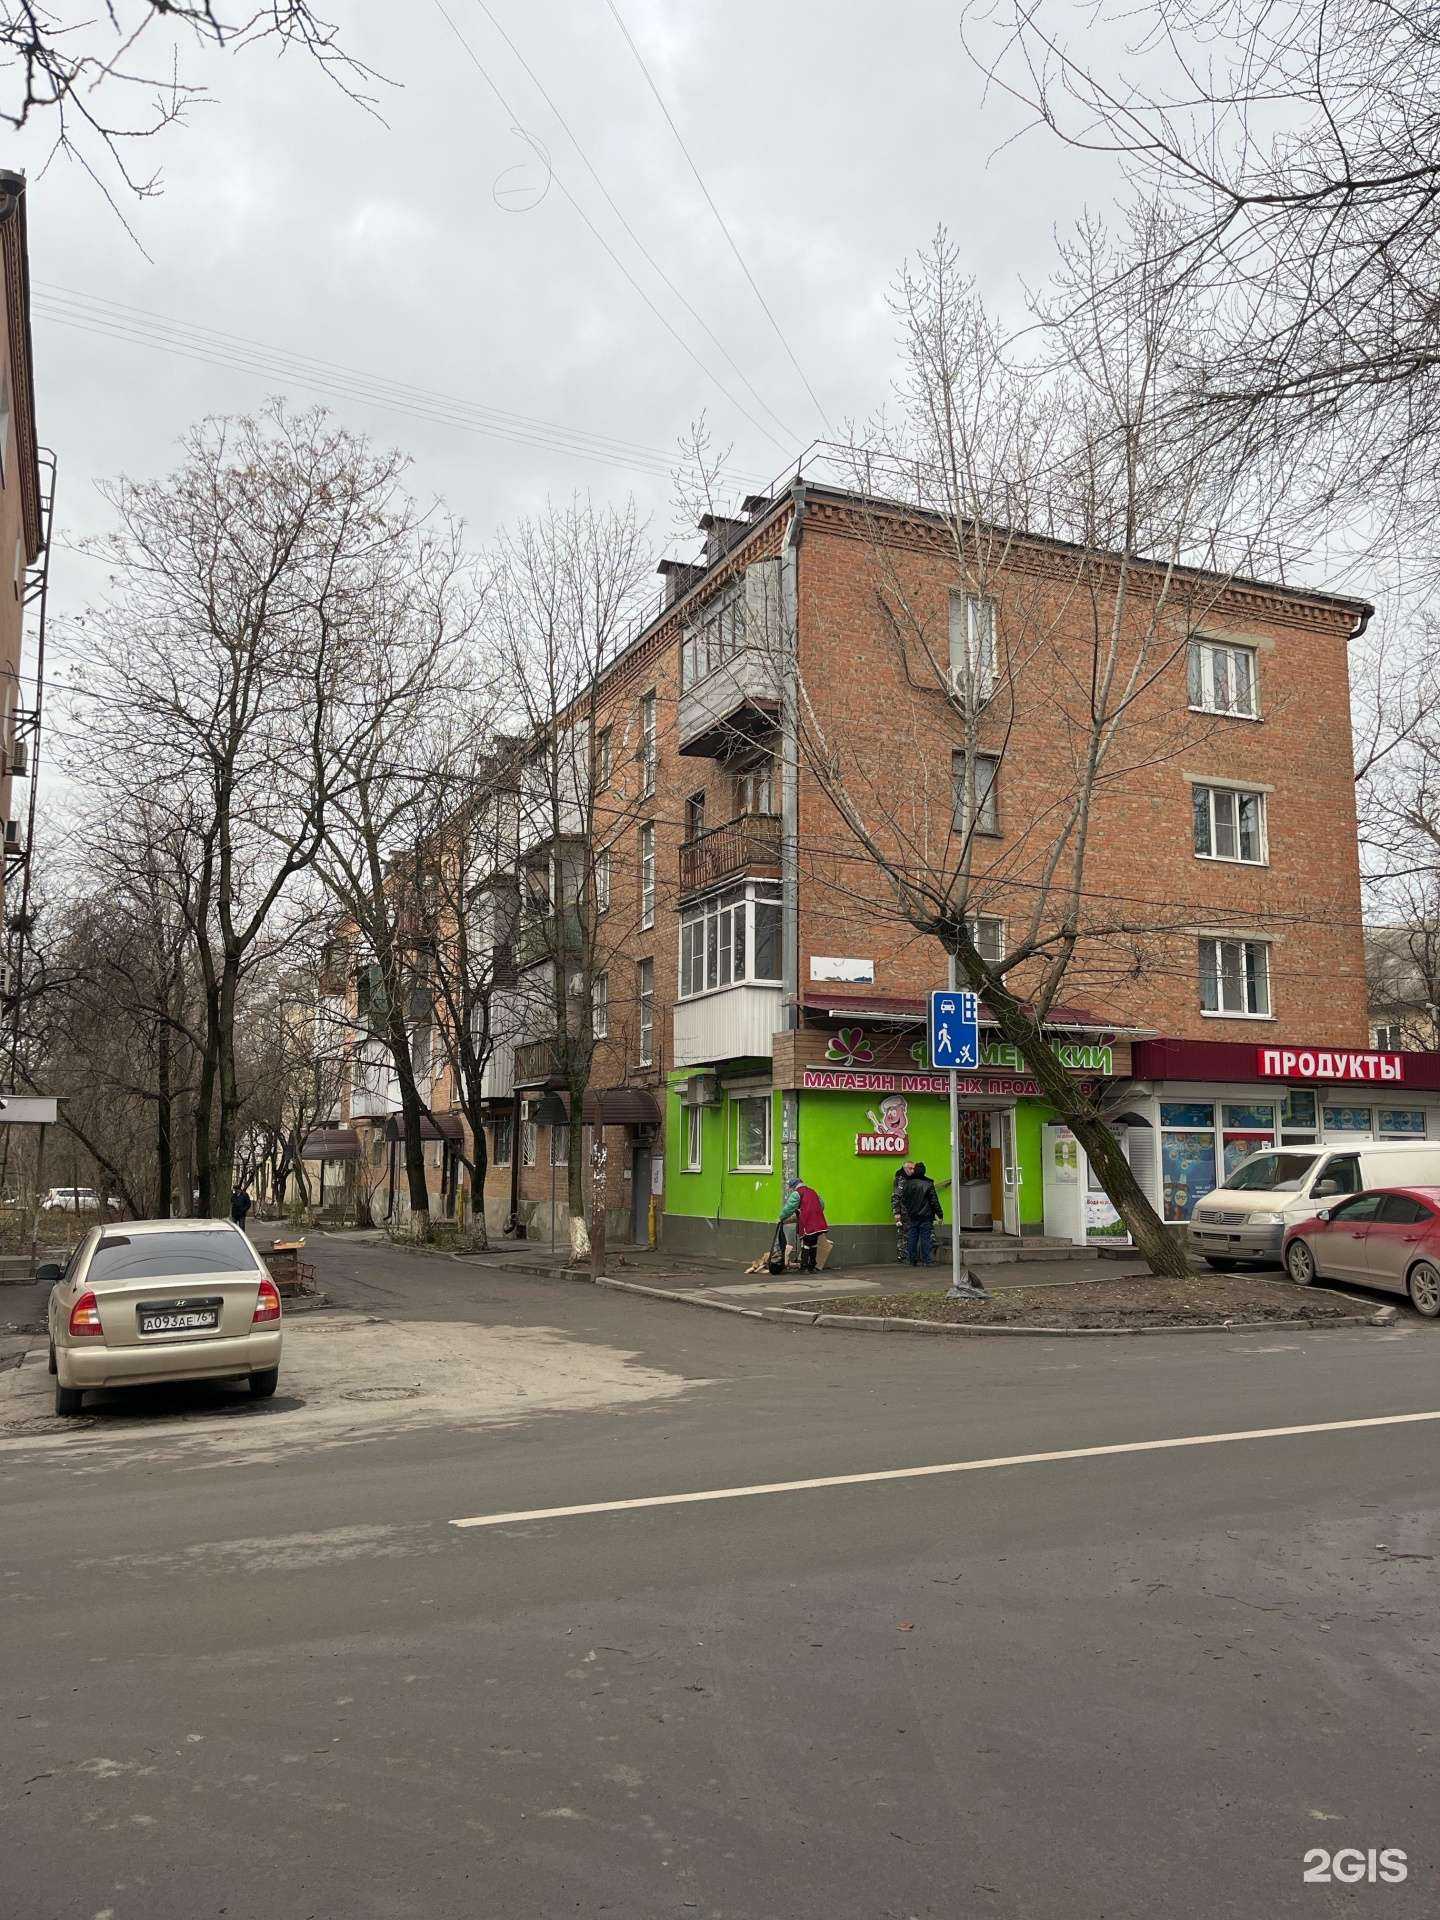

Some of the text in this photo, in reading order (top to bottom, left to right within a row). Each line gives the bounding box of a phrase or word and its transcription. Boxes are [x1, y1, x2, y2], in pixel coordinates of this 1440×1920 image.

[1264, 1051, 1401, 1080] ПРОДУКТЫ
[803, 1072, 895, 1091] МАГАЗИН
[988, 1079, 1092, 1097] ПРОДВ
[861, 1136, 905, 1152] МЯСО
